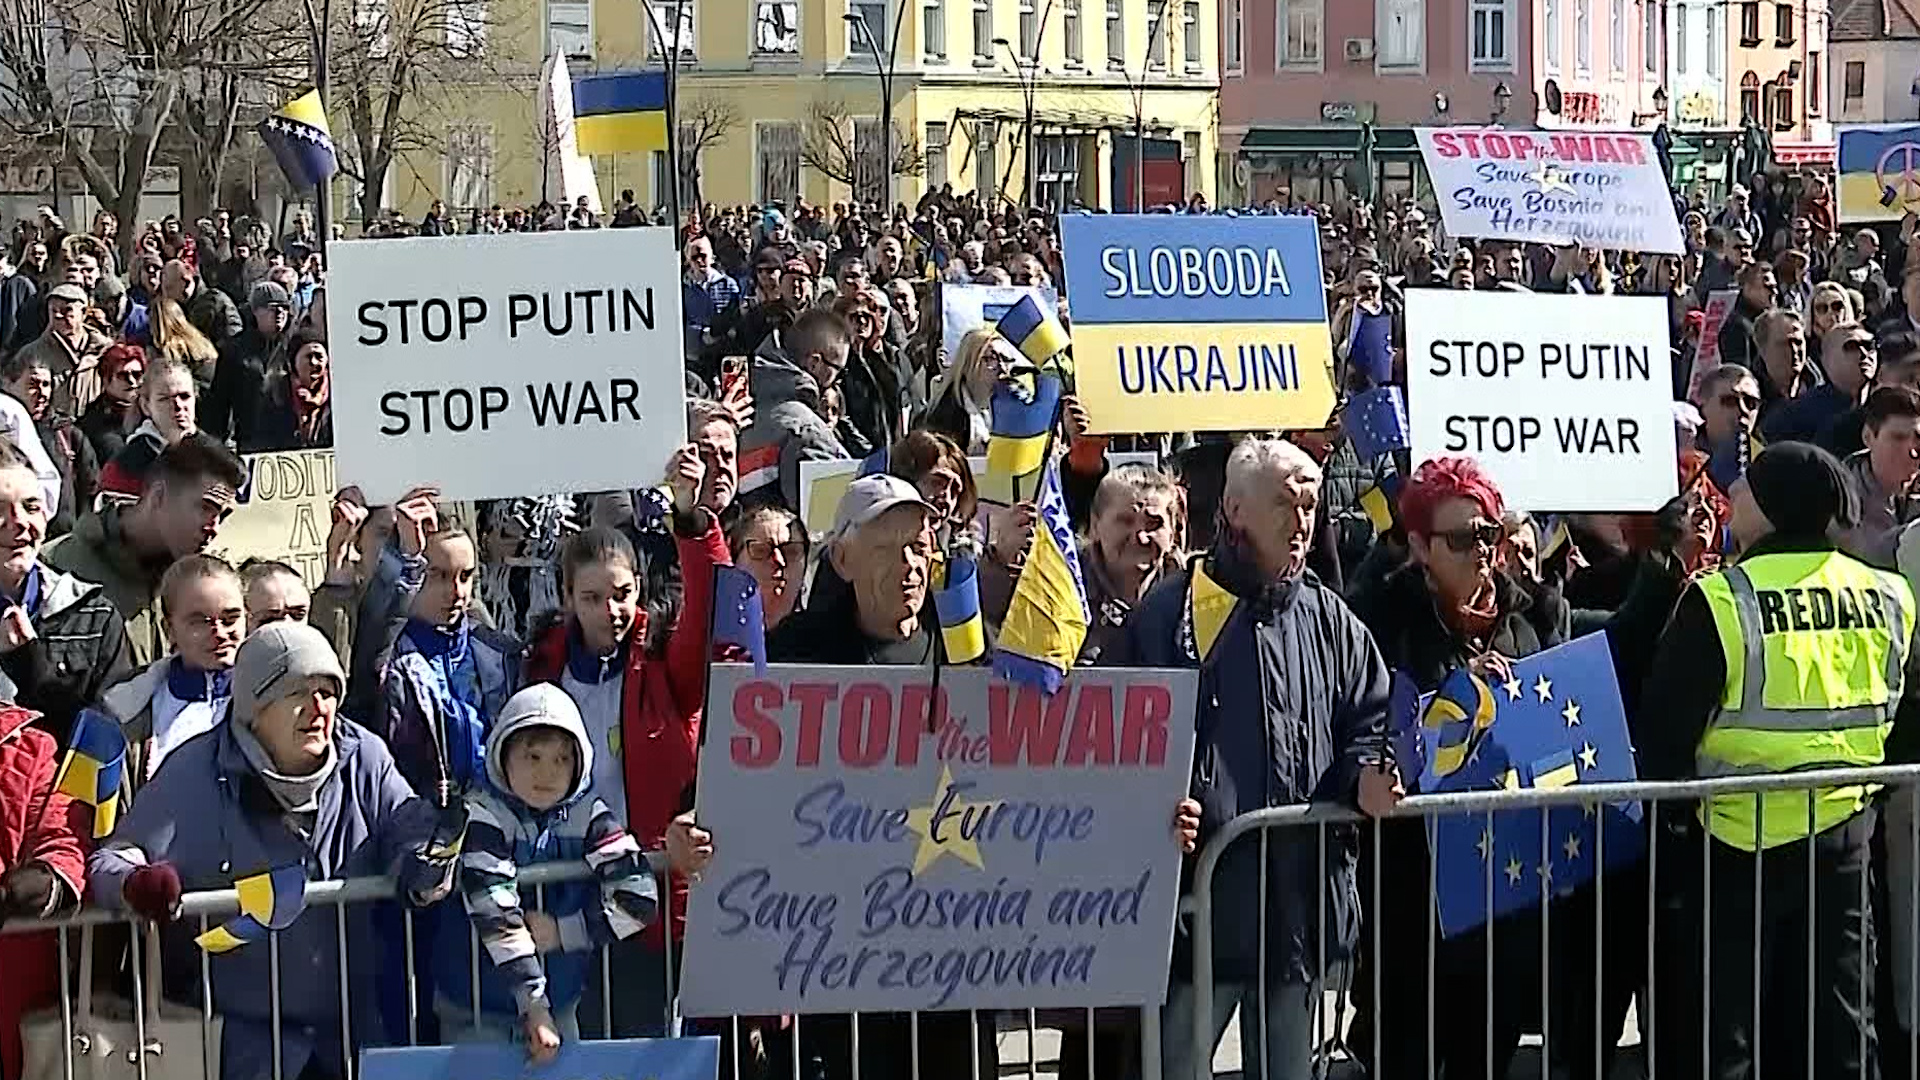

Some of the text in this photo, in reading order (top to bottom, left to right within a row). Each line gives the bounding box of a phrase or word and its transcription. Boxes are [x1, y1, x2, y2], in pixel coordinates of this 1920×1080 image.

[1432, 132, 1534, 160] STOP
[1549, 136, 1648, 165] WAR
[1476, 162, 1534, 184] Save
[1453, 186, 1512, 211] Save
[1522, 190, 1604, 215] Bosnia
[1102, 247, 1291, 296] SLOBODA
[357, 287, 655, 347] STOP PUTIN
[1118, 343, 1299, 394] UKRAJINI
[1429, 340, 1650, 381] STOP PUTIN
[380, 378, 642, 437] STOP WAR
[1445, 415, 1641, 454] STOP WAR
[1756, 587, 1888, 634] REDAR
[729, 681, 1172, 767] STOP the WAR
[793, 779, 1095, 865] Save Europe
[717, 866, 1152, 938] Save Bosnia and
[774, 932, 1096, 1009] Herzegovina
